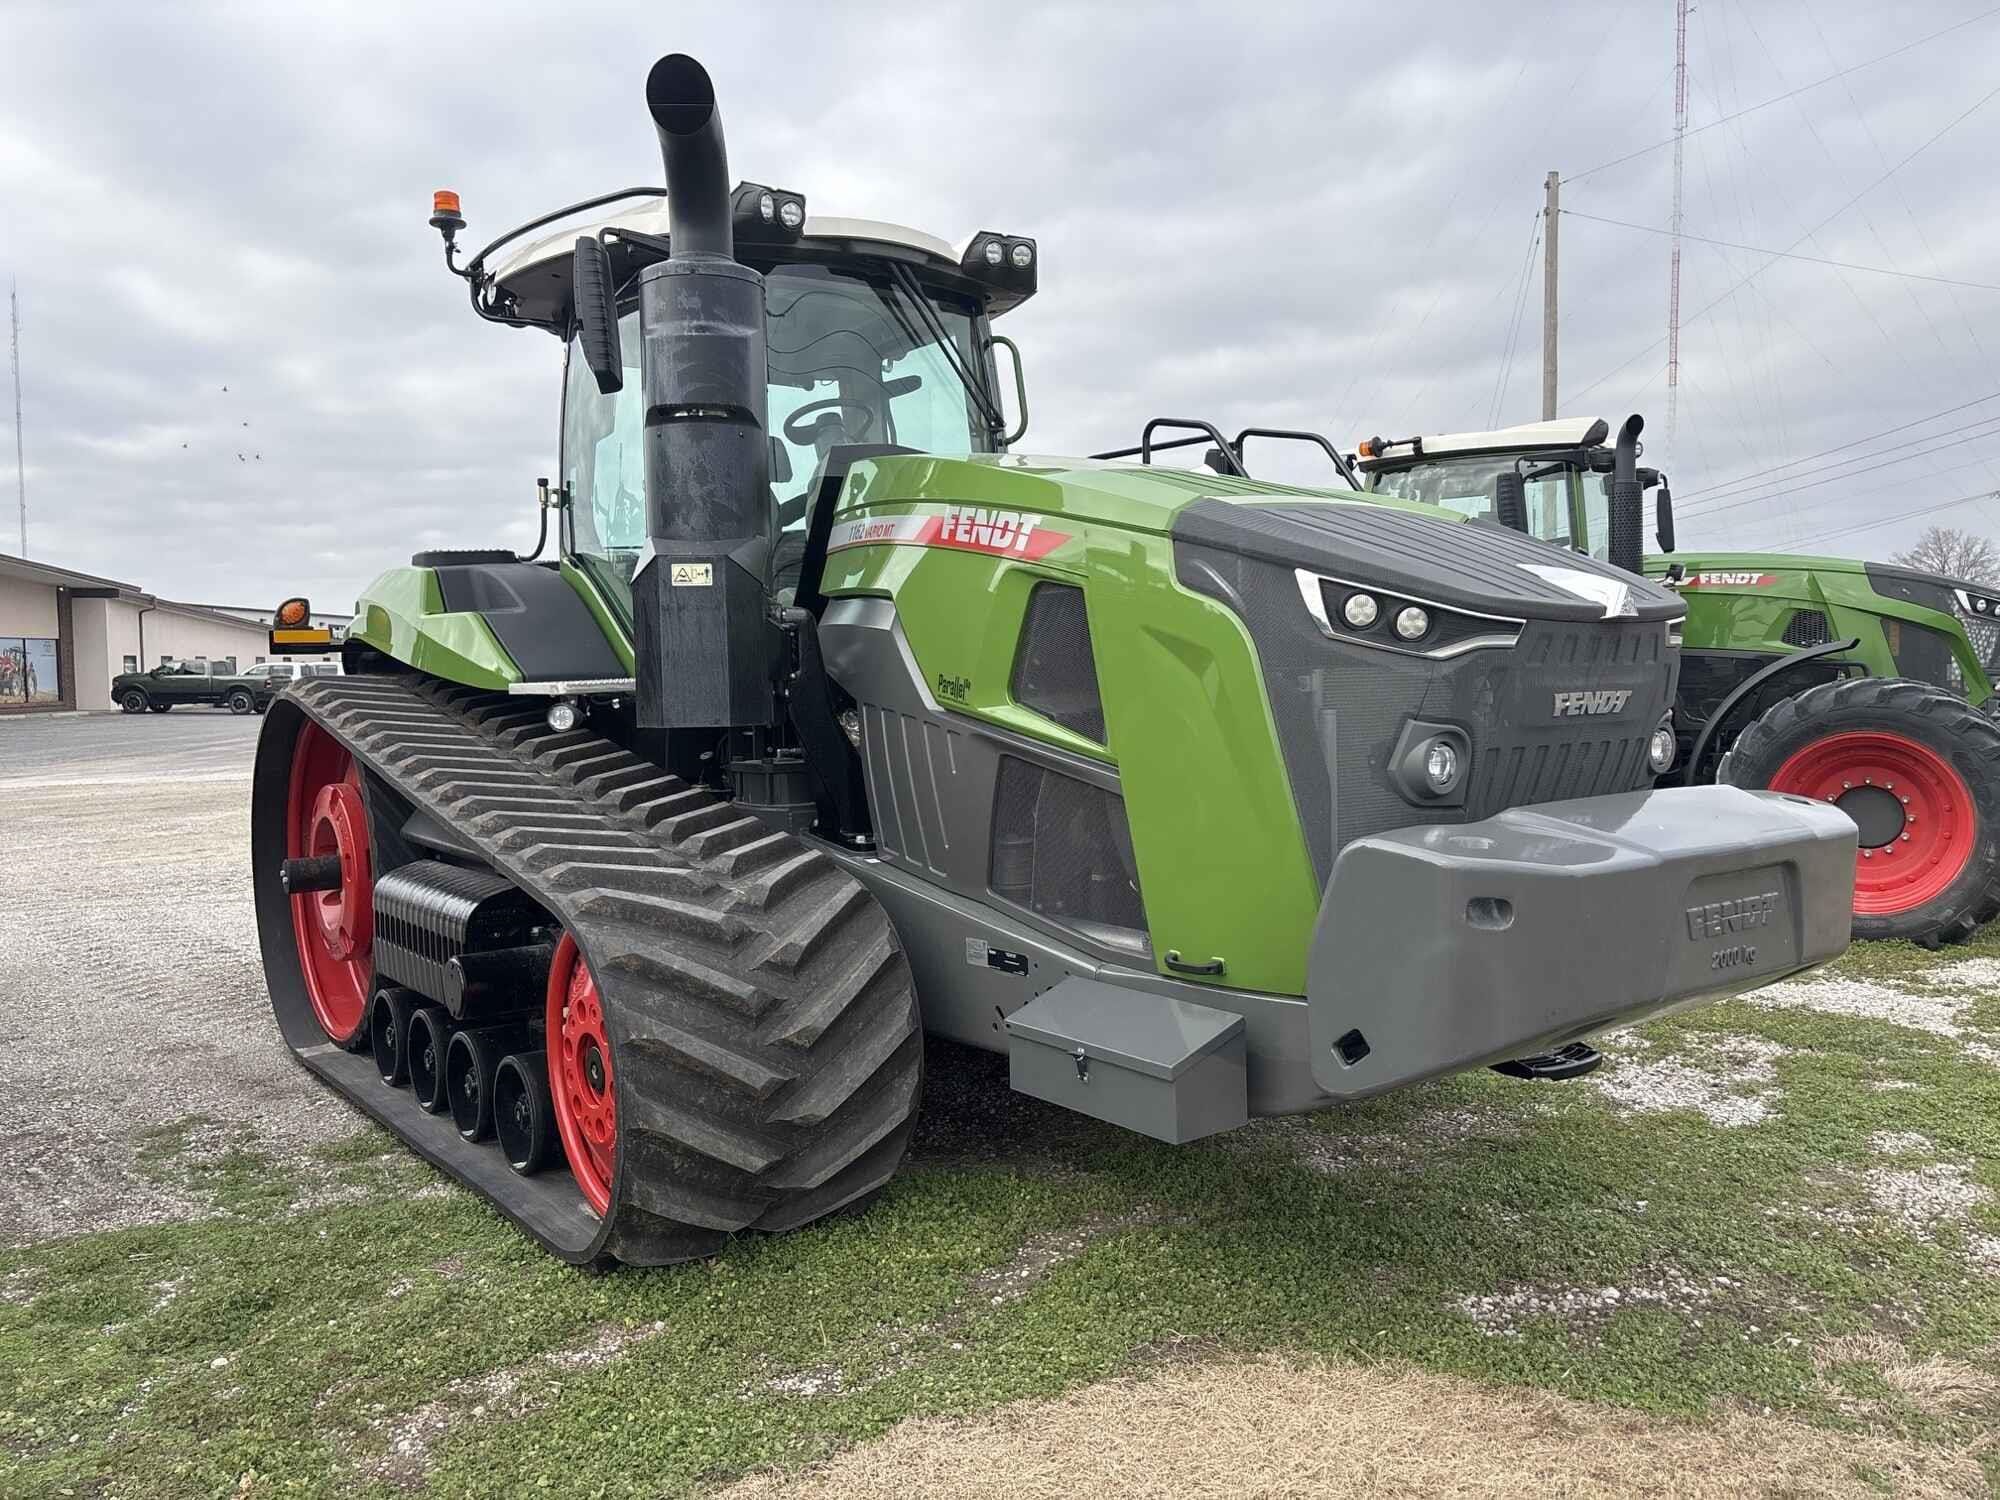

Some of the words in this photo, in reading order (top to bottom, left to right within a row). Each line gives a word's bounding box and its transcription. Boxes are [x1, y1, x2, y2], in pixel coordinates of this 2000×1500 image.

[848, 523, 865, 542] 1162
[940, 505, 1043, 551] FENDT
[1698, 572, 1764, 585] FENDT
[1552, 690, 1632, 717] FENDT
[1686, 891, 1778, 941] FENDT
[1711, 946, 1738, 969] 2000
